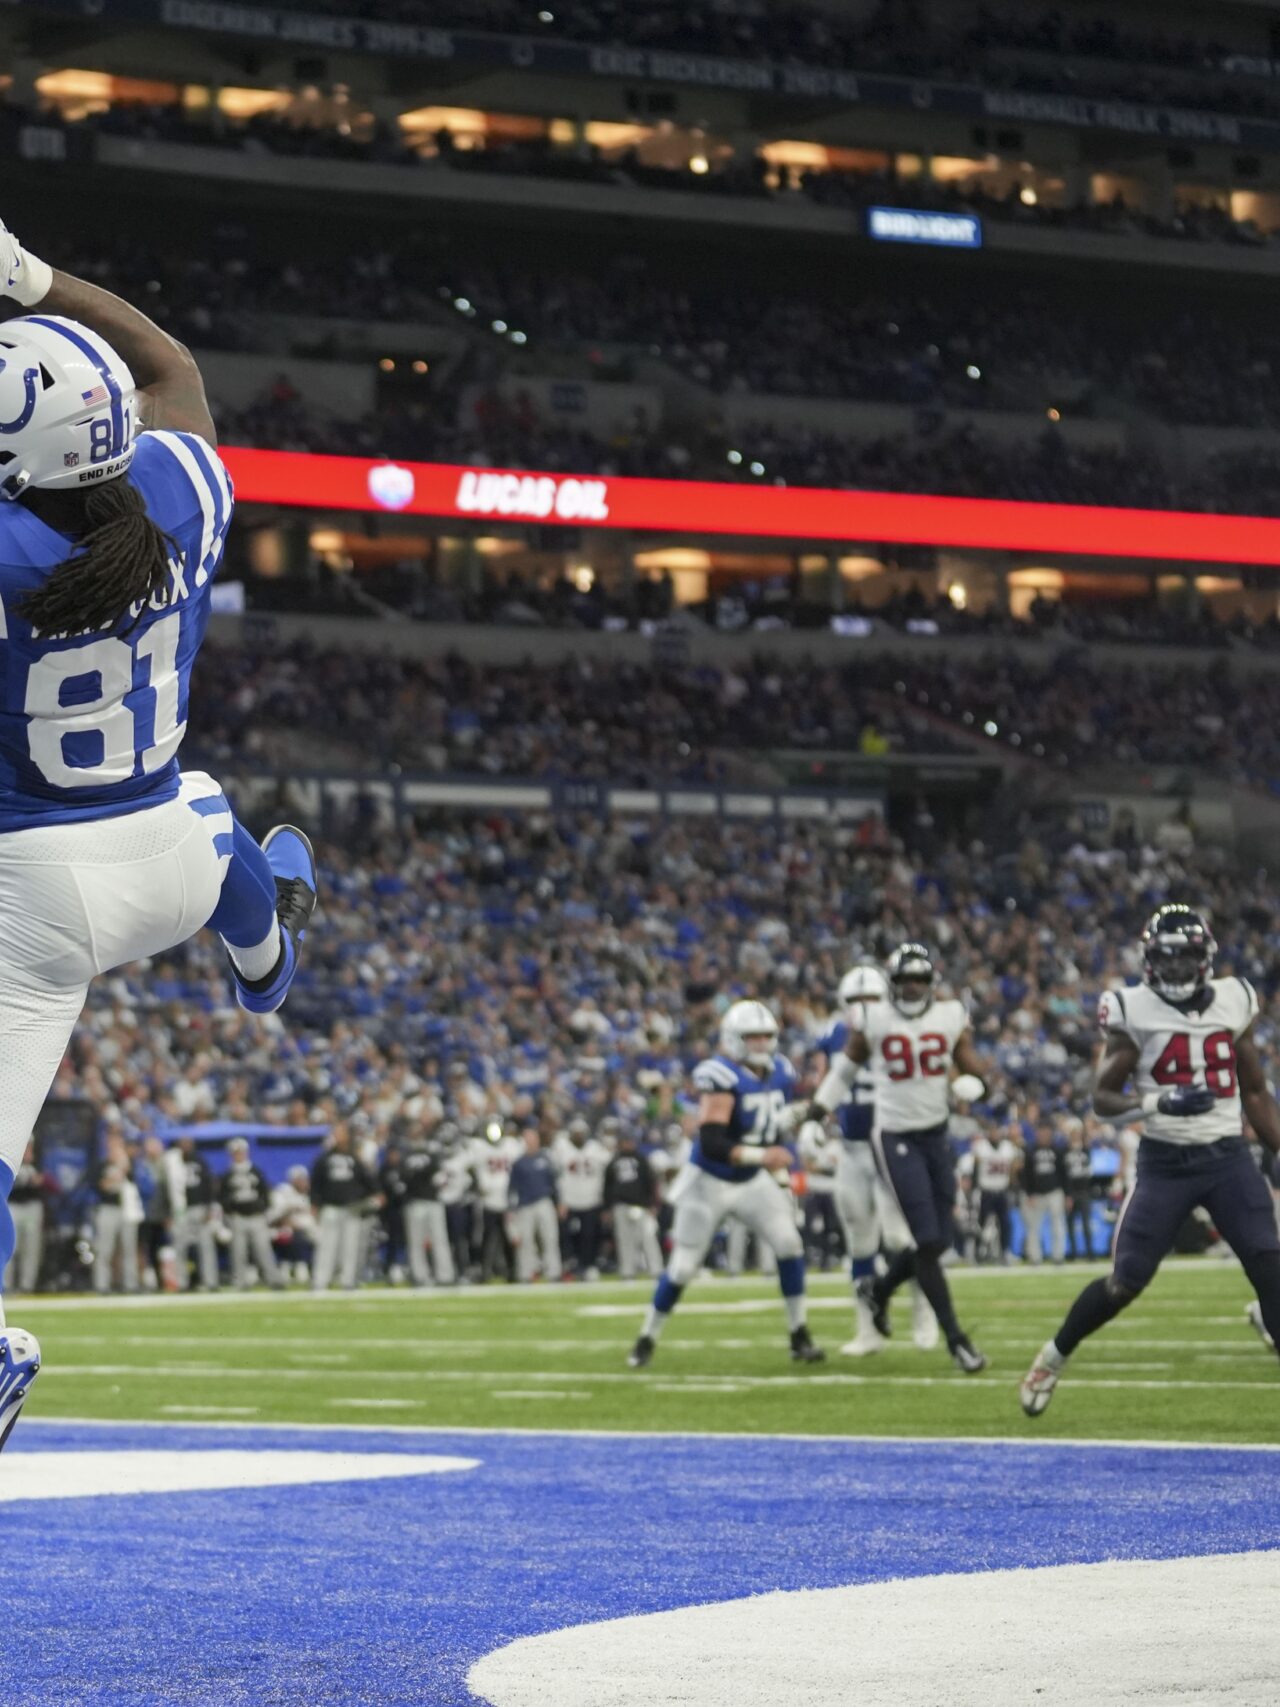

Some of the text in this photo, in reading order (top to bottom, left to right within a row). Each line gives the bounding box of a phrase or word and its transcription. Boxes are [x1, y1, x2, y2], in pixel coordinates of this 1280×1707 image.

[90, 408, 129, 464] 81
[79, 468, 104, 482] END
[456, 471, 609, 520] LUCAS OIL
[24, 611, 187, 788] 81
[882, 1033, 948, 1081] 92
[1151, 1031, 1237, 1098] 48
